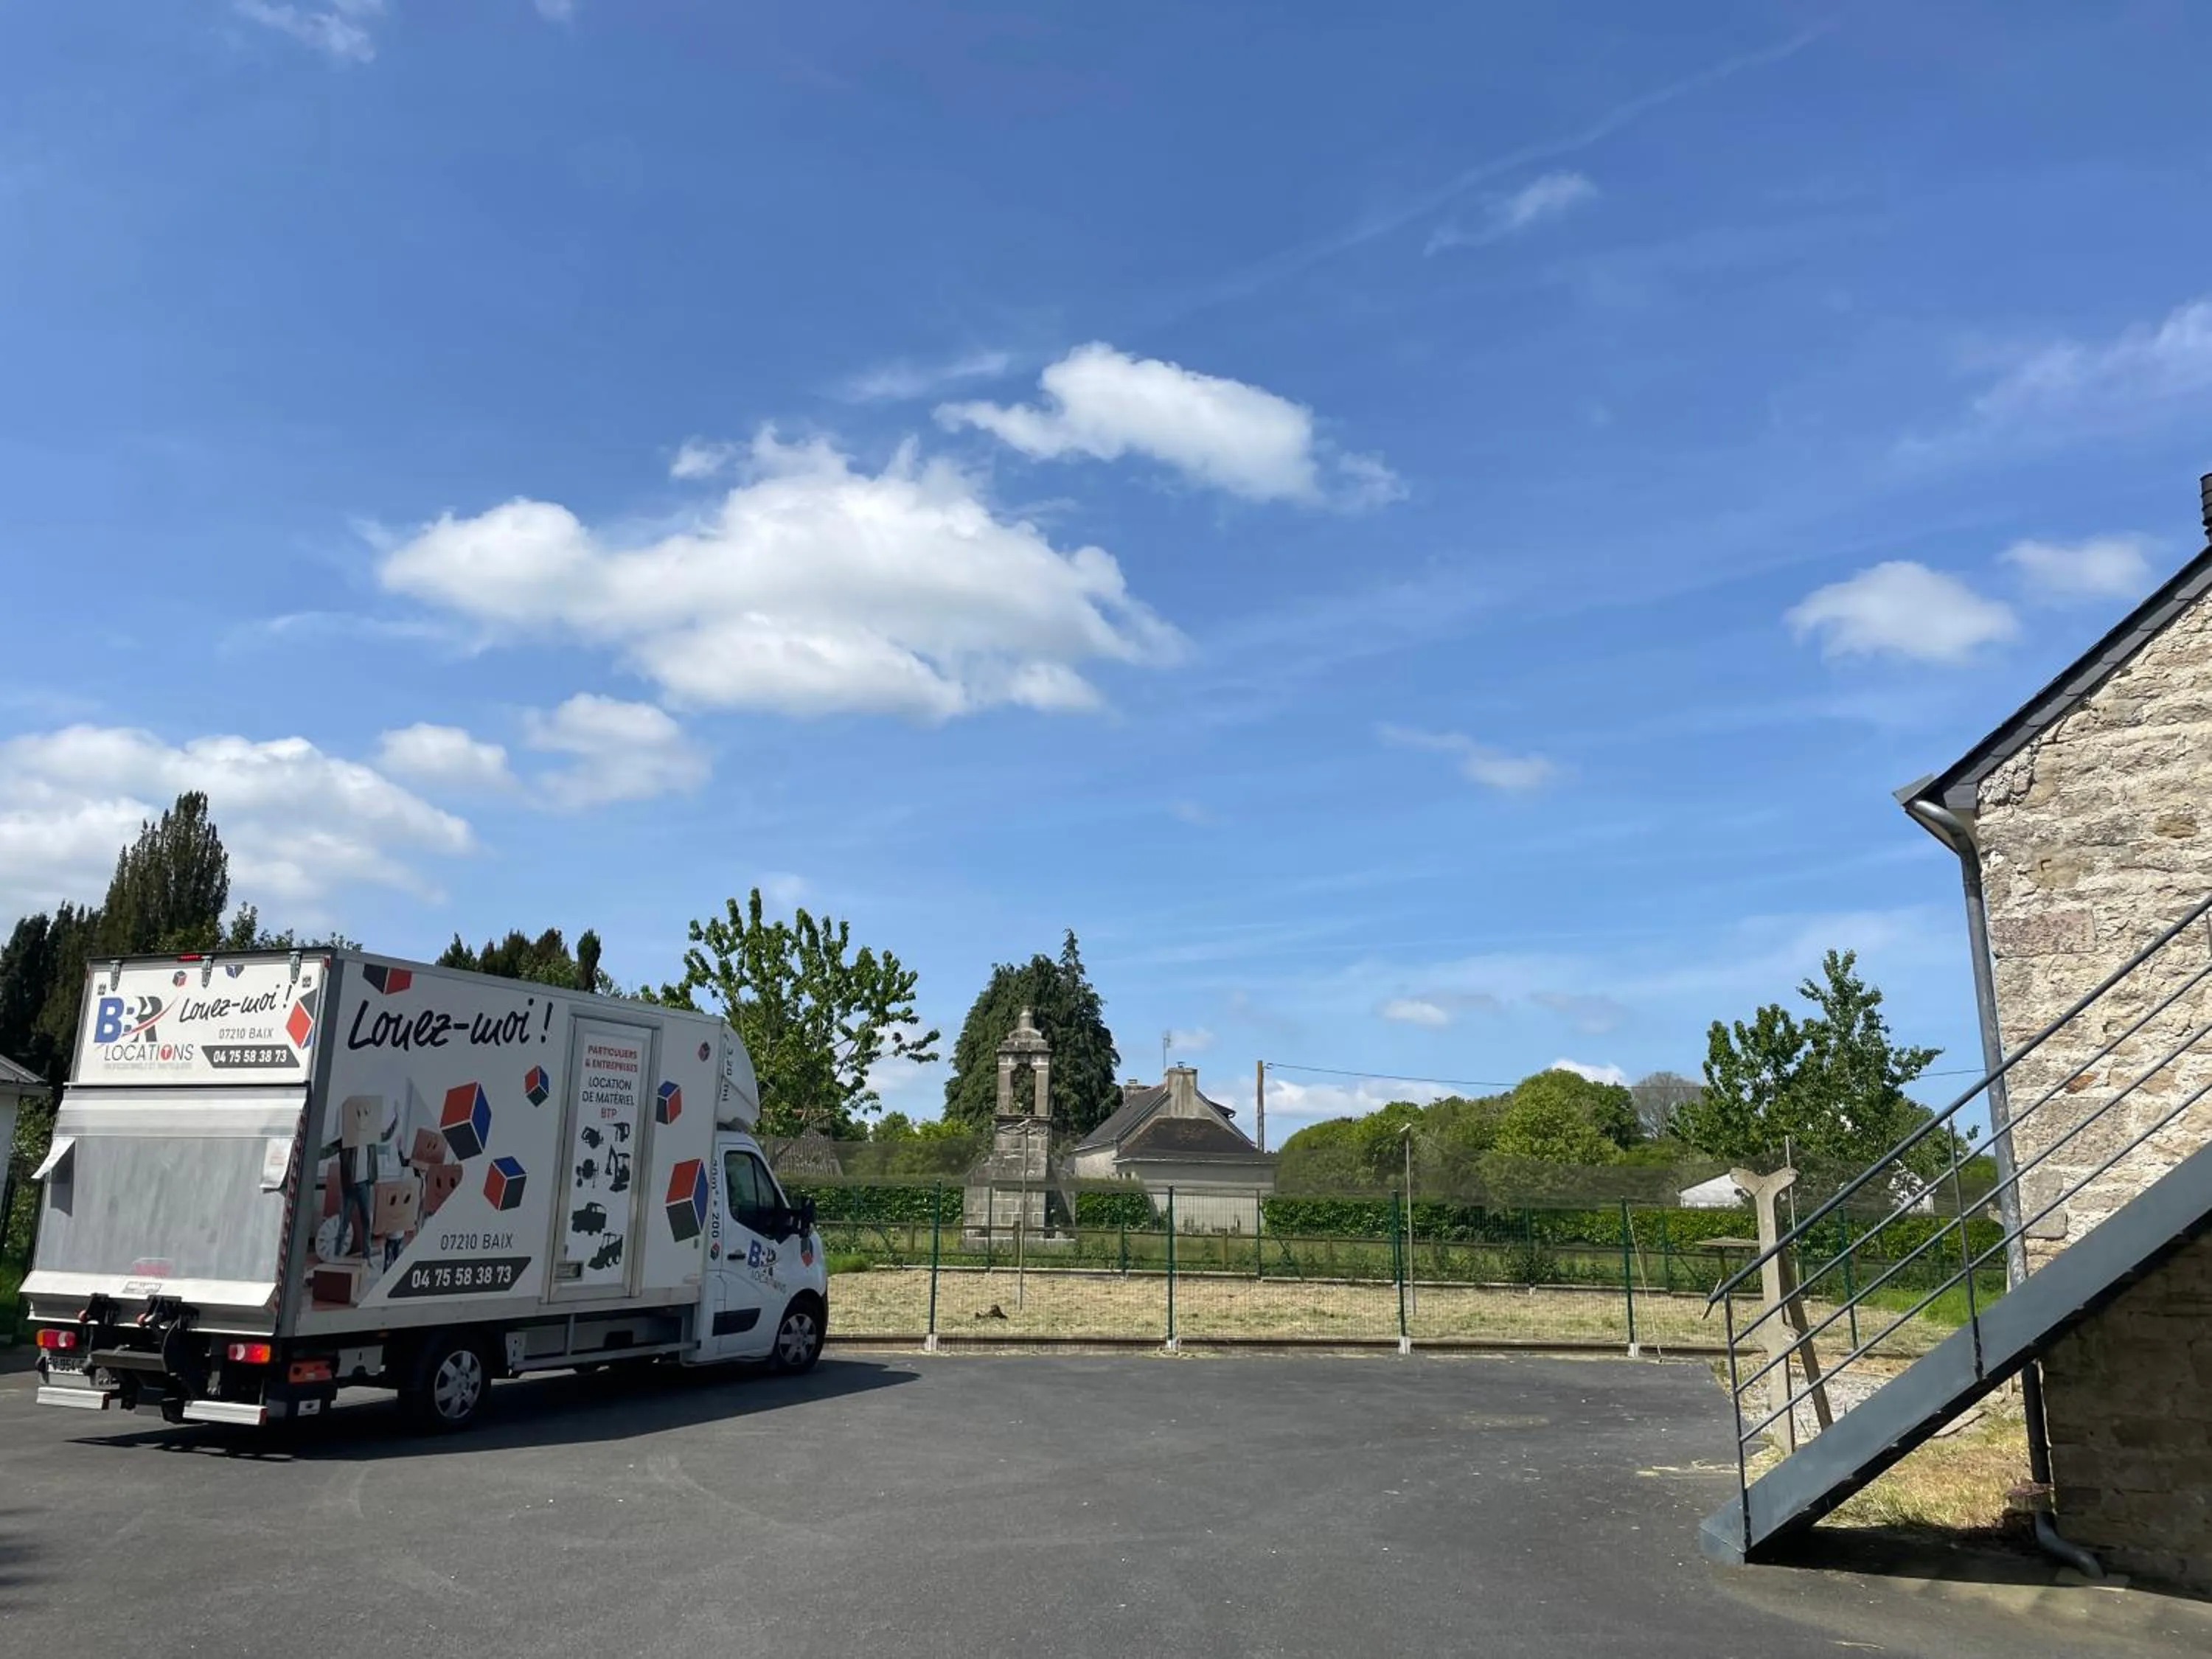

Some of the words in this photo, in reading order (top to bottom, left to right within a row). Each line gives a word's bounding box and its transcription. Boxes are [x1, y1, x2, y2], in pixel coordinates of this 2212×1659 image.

[179, 984, 280, 1023] Louez-moi
[347, 998, 535, 1051] Louez-moi
[218, 1028, 246, 1040] 07210
[248, 1027, 274, 1040] BAIX
[104, 1043, 195, 1061] LOCATIONS
[213, 1050, 226, 1062] 04
[229, 1050, 241, 1062] 75
[243, 1050, 256, 1062] 58
[259, 1049, 272, 1062] 38
[274, 1048, 288, 1062] 73
[588, 1045, 638, 1059] PARTICULIERS
[588, 1076, 632, 1091] LOCATION
[582, 1091, 594, 1103] DE
[601, 1107, 617, 1119] BTP
[440, 1234, 478, 1251] 07210
[482, 1233, 514, 1250] BAIX
[411, 1269, 431, 1289] 04
[434, 1268, 451, 1287] 75
[455, 1267, 473, 1286] 58
[476, 1266, 493, 1284] 38
[496, 1265, 512, 1284] 73
